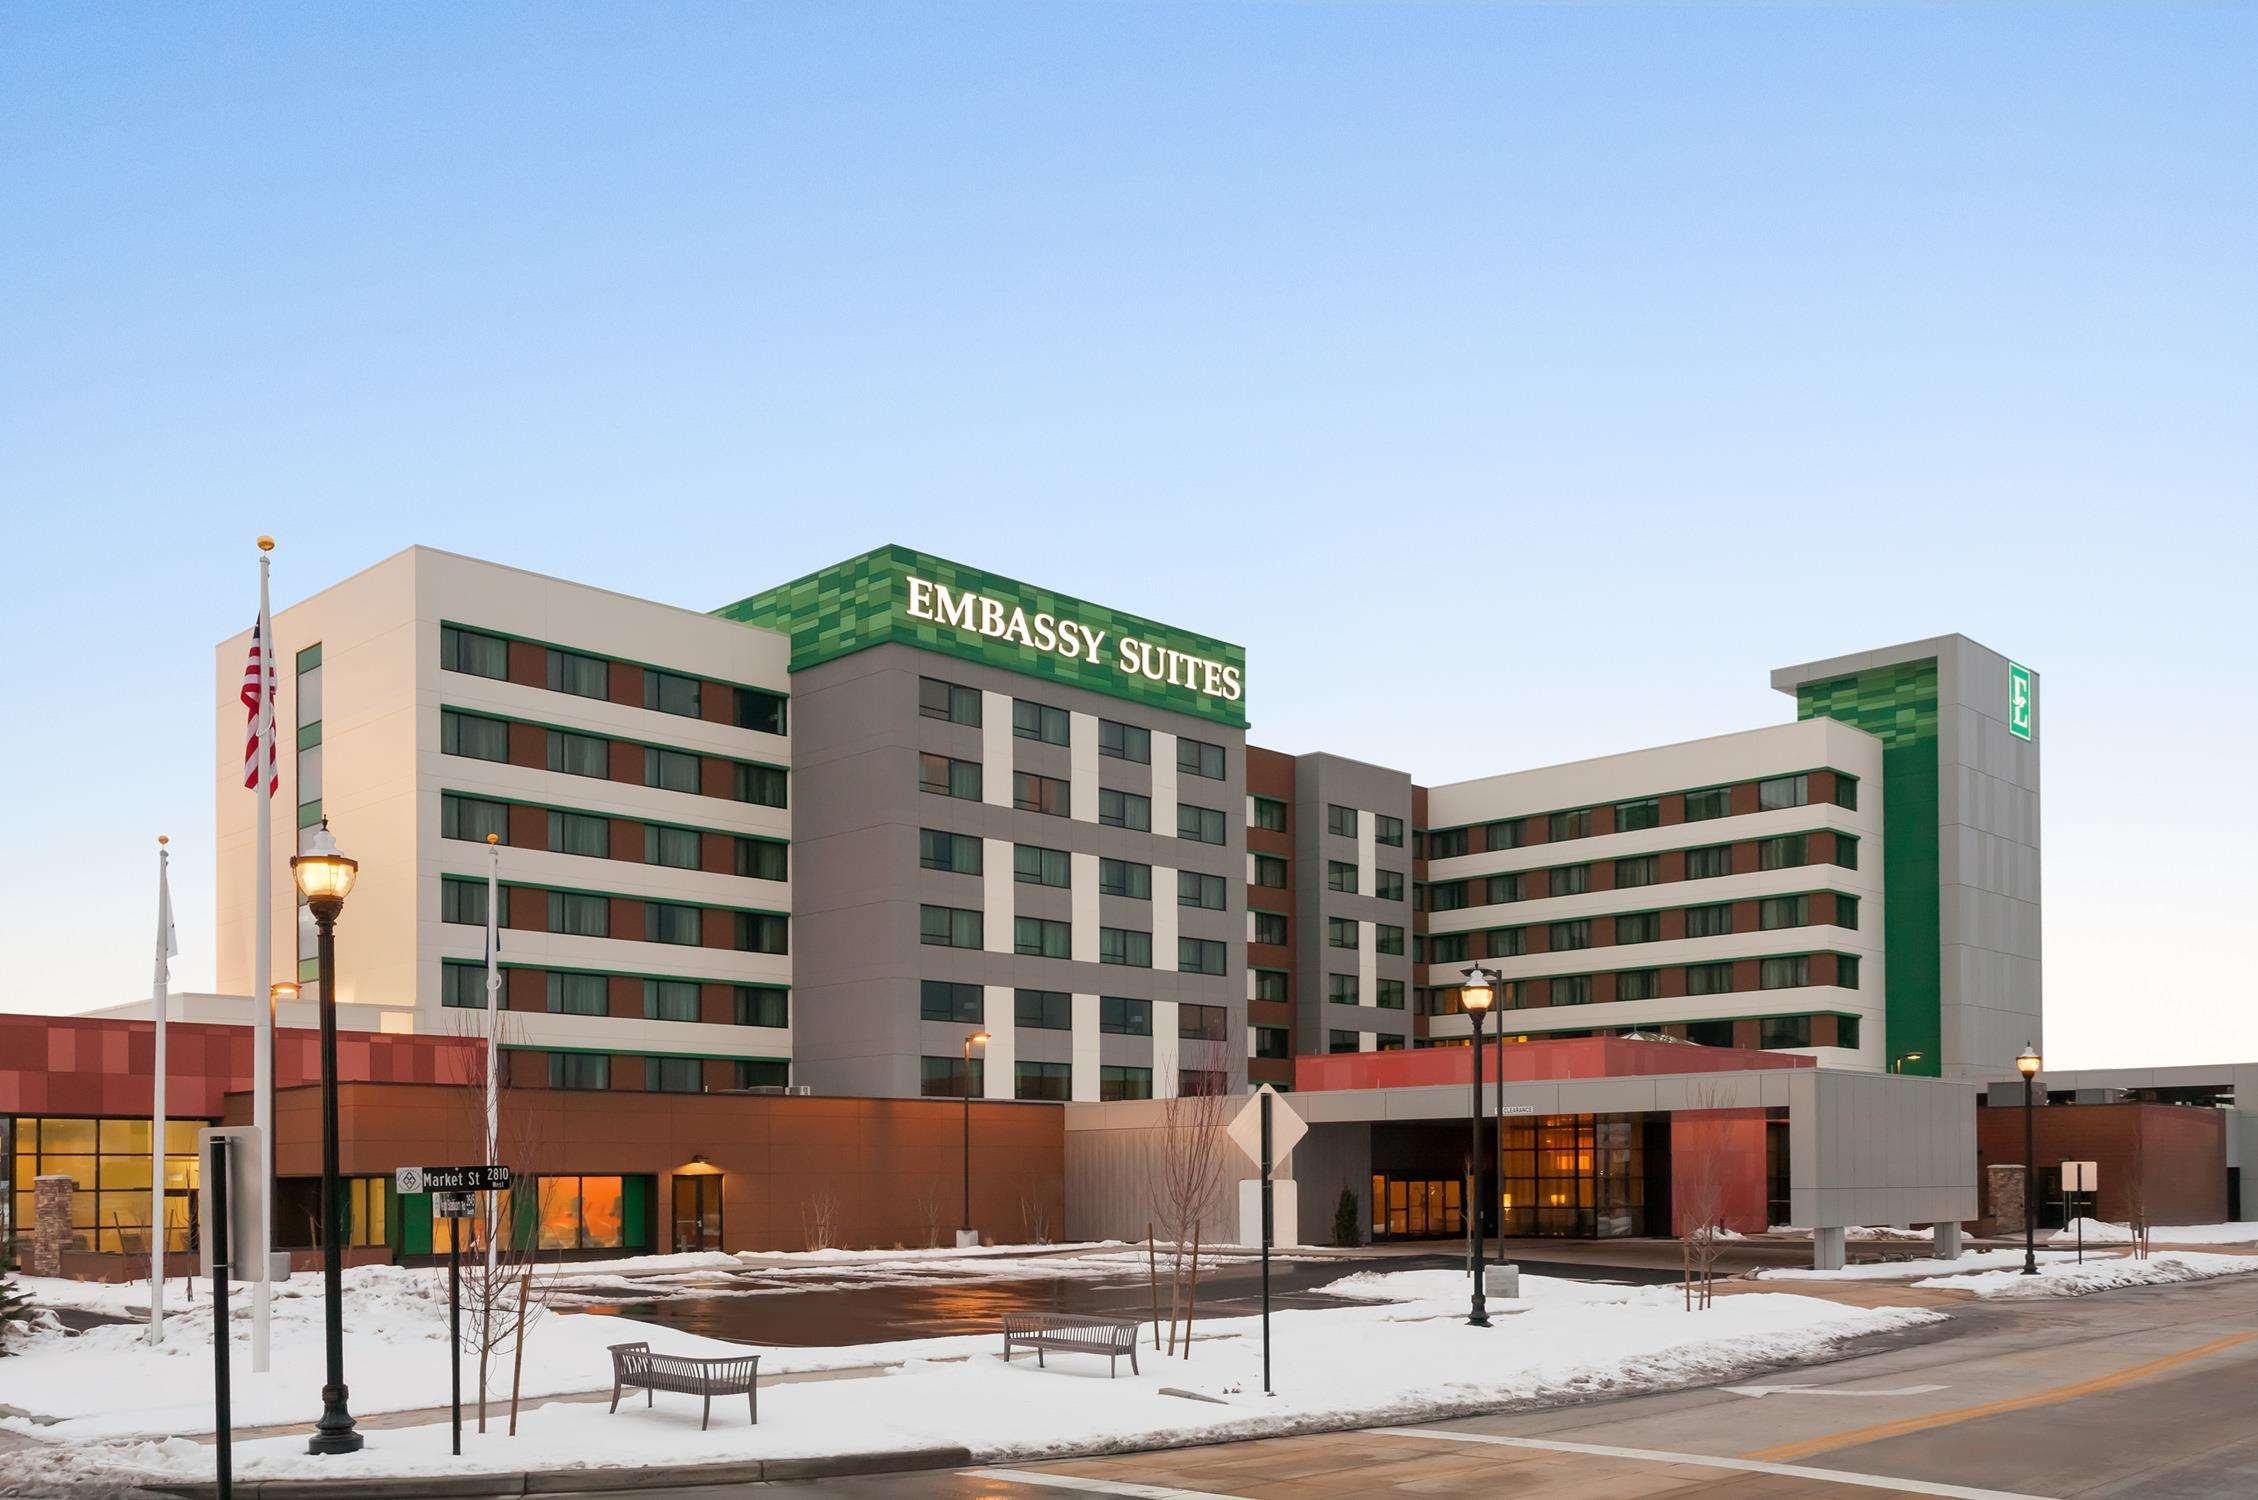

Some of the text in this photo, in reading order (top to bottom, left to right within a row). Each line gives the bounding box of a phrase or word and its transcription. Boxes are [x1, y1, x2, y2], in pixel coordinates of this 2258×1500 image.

[906, 576, 1241, 701] EMBASSY SUITES
[423, 1173, 463, 1187] Market
[468, 1172, 480, 1186] St
[487, 1167, 509, 1180] 2810
